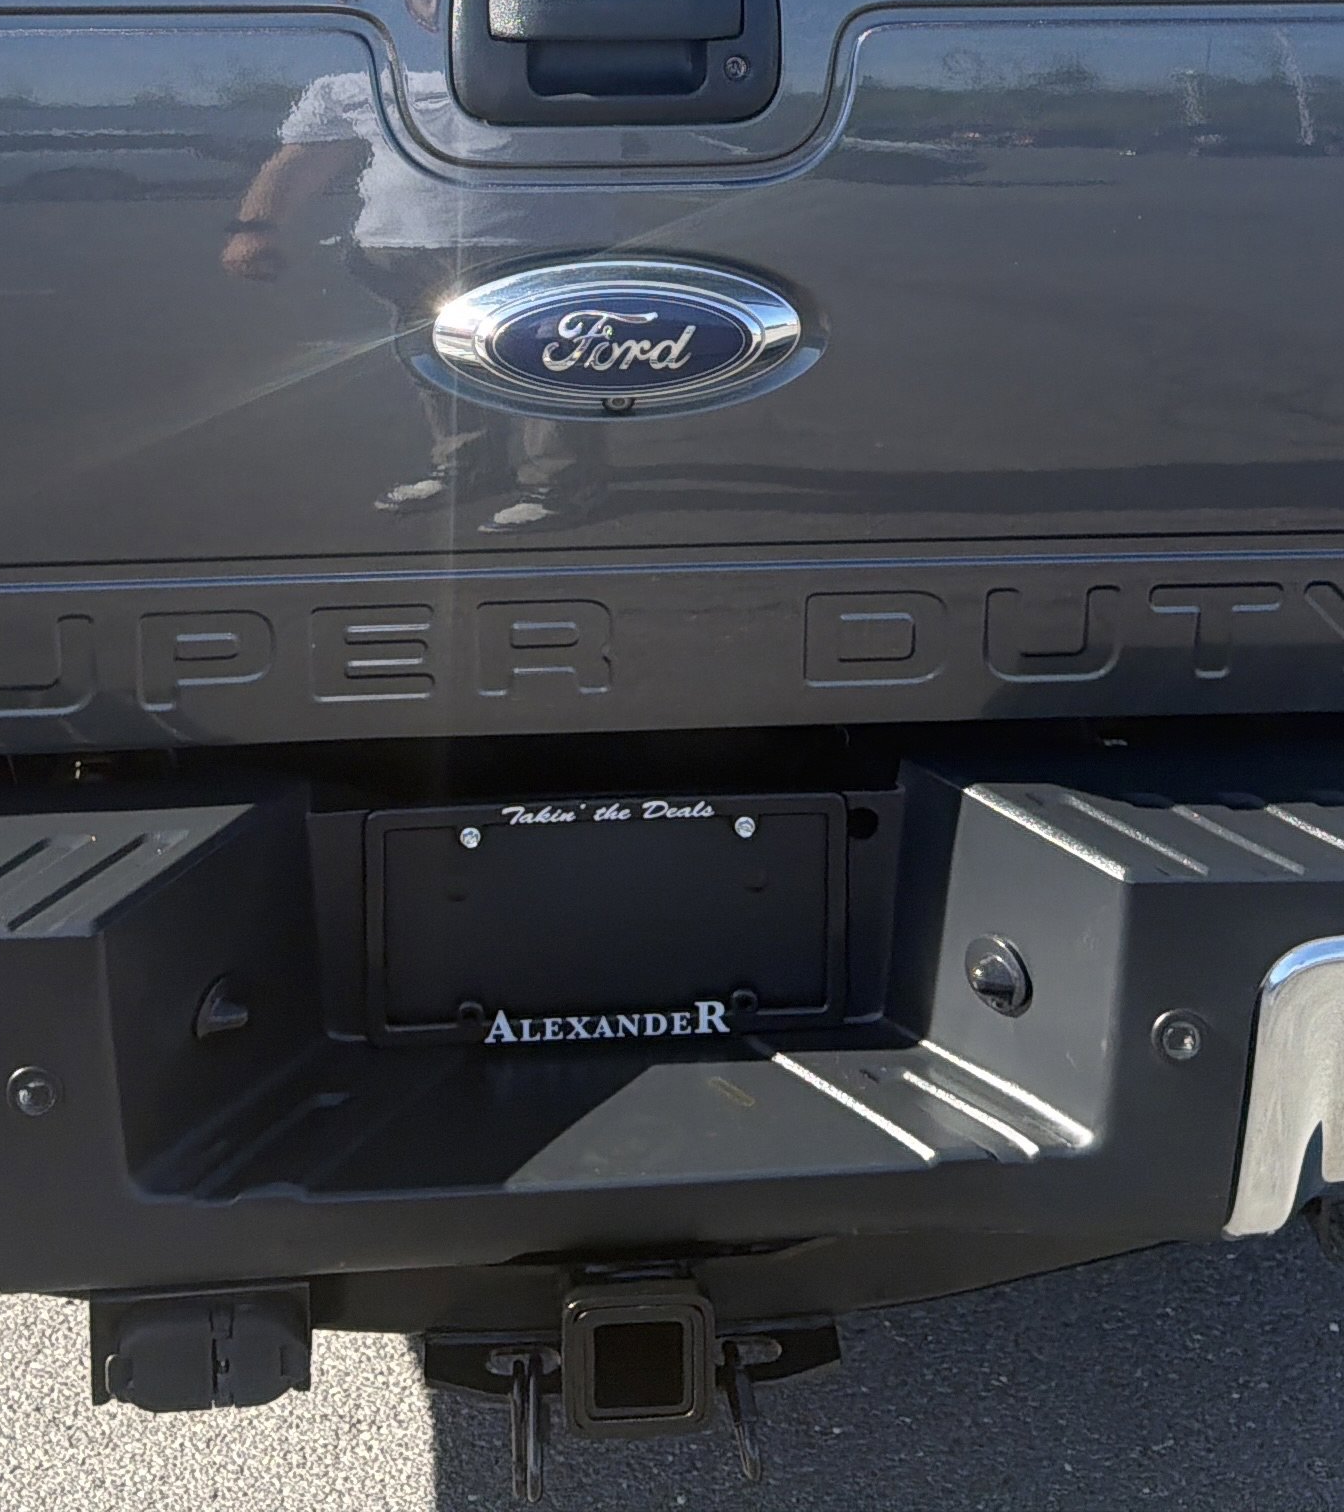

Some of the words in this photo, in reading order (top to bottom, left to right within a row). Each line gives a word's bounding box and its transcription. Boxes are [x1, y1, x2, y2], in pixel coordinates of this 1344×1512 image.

[542, 310, 697, 372] Ford
[501, 803, 586, 825] Takin'
[593, 803, 632, 822] the
[642, 800, 716, 820] Deals
[483, 1000, 731, 1044] ALEXANDER
